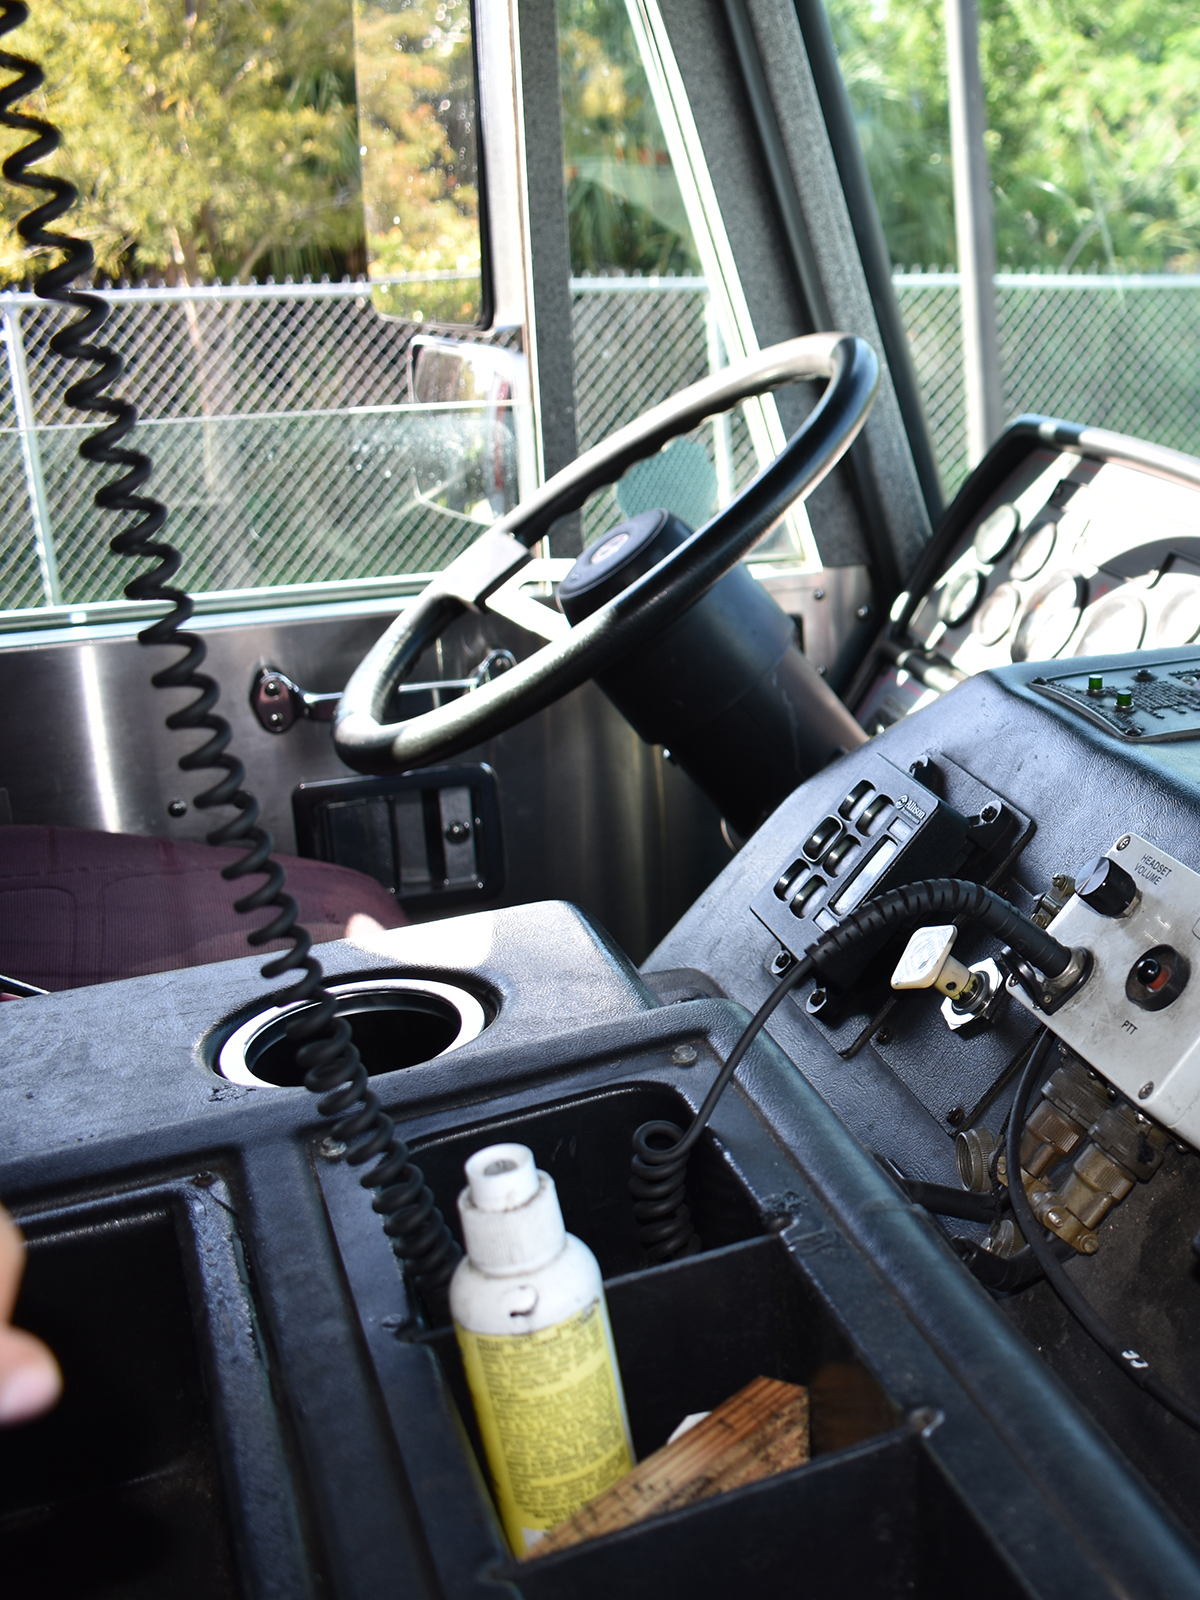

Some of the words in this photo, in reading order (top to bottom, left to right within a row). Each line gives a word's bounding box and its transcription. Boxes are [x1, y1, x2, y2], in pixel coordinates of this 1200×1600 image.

[905, 800, 926, 820] Allison
[1134, 863, 1162, 886] VOLUME
[1140, 854, 1172, 878] HEADSET
[1121, 1020, 1138, 1035] PTT
